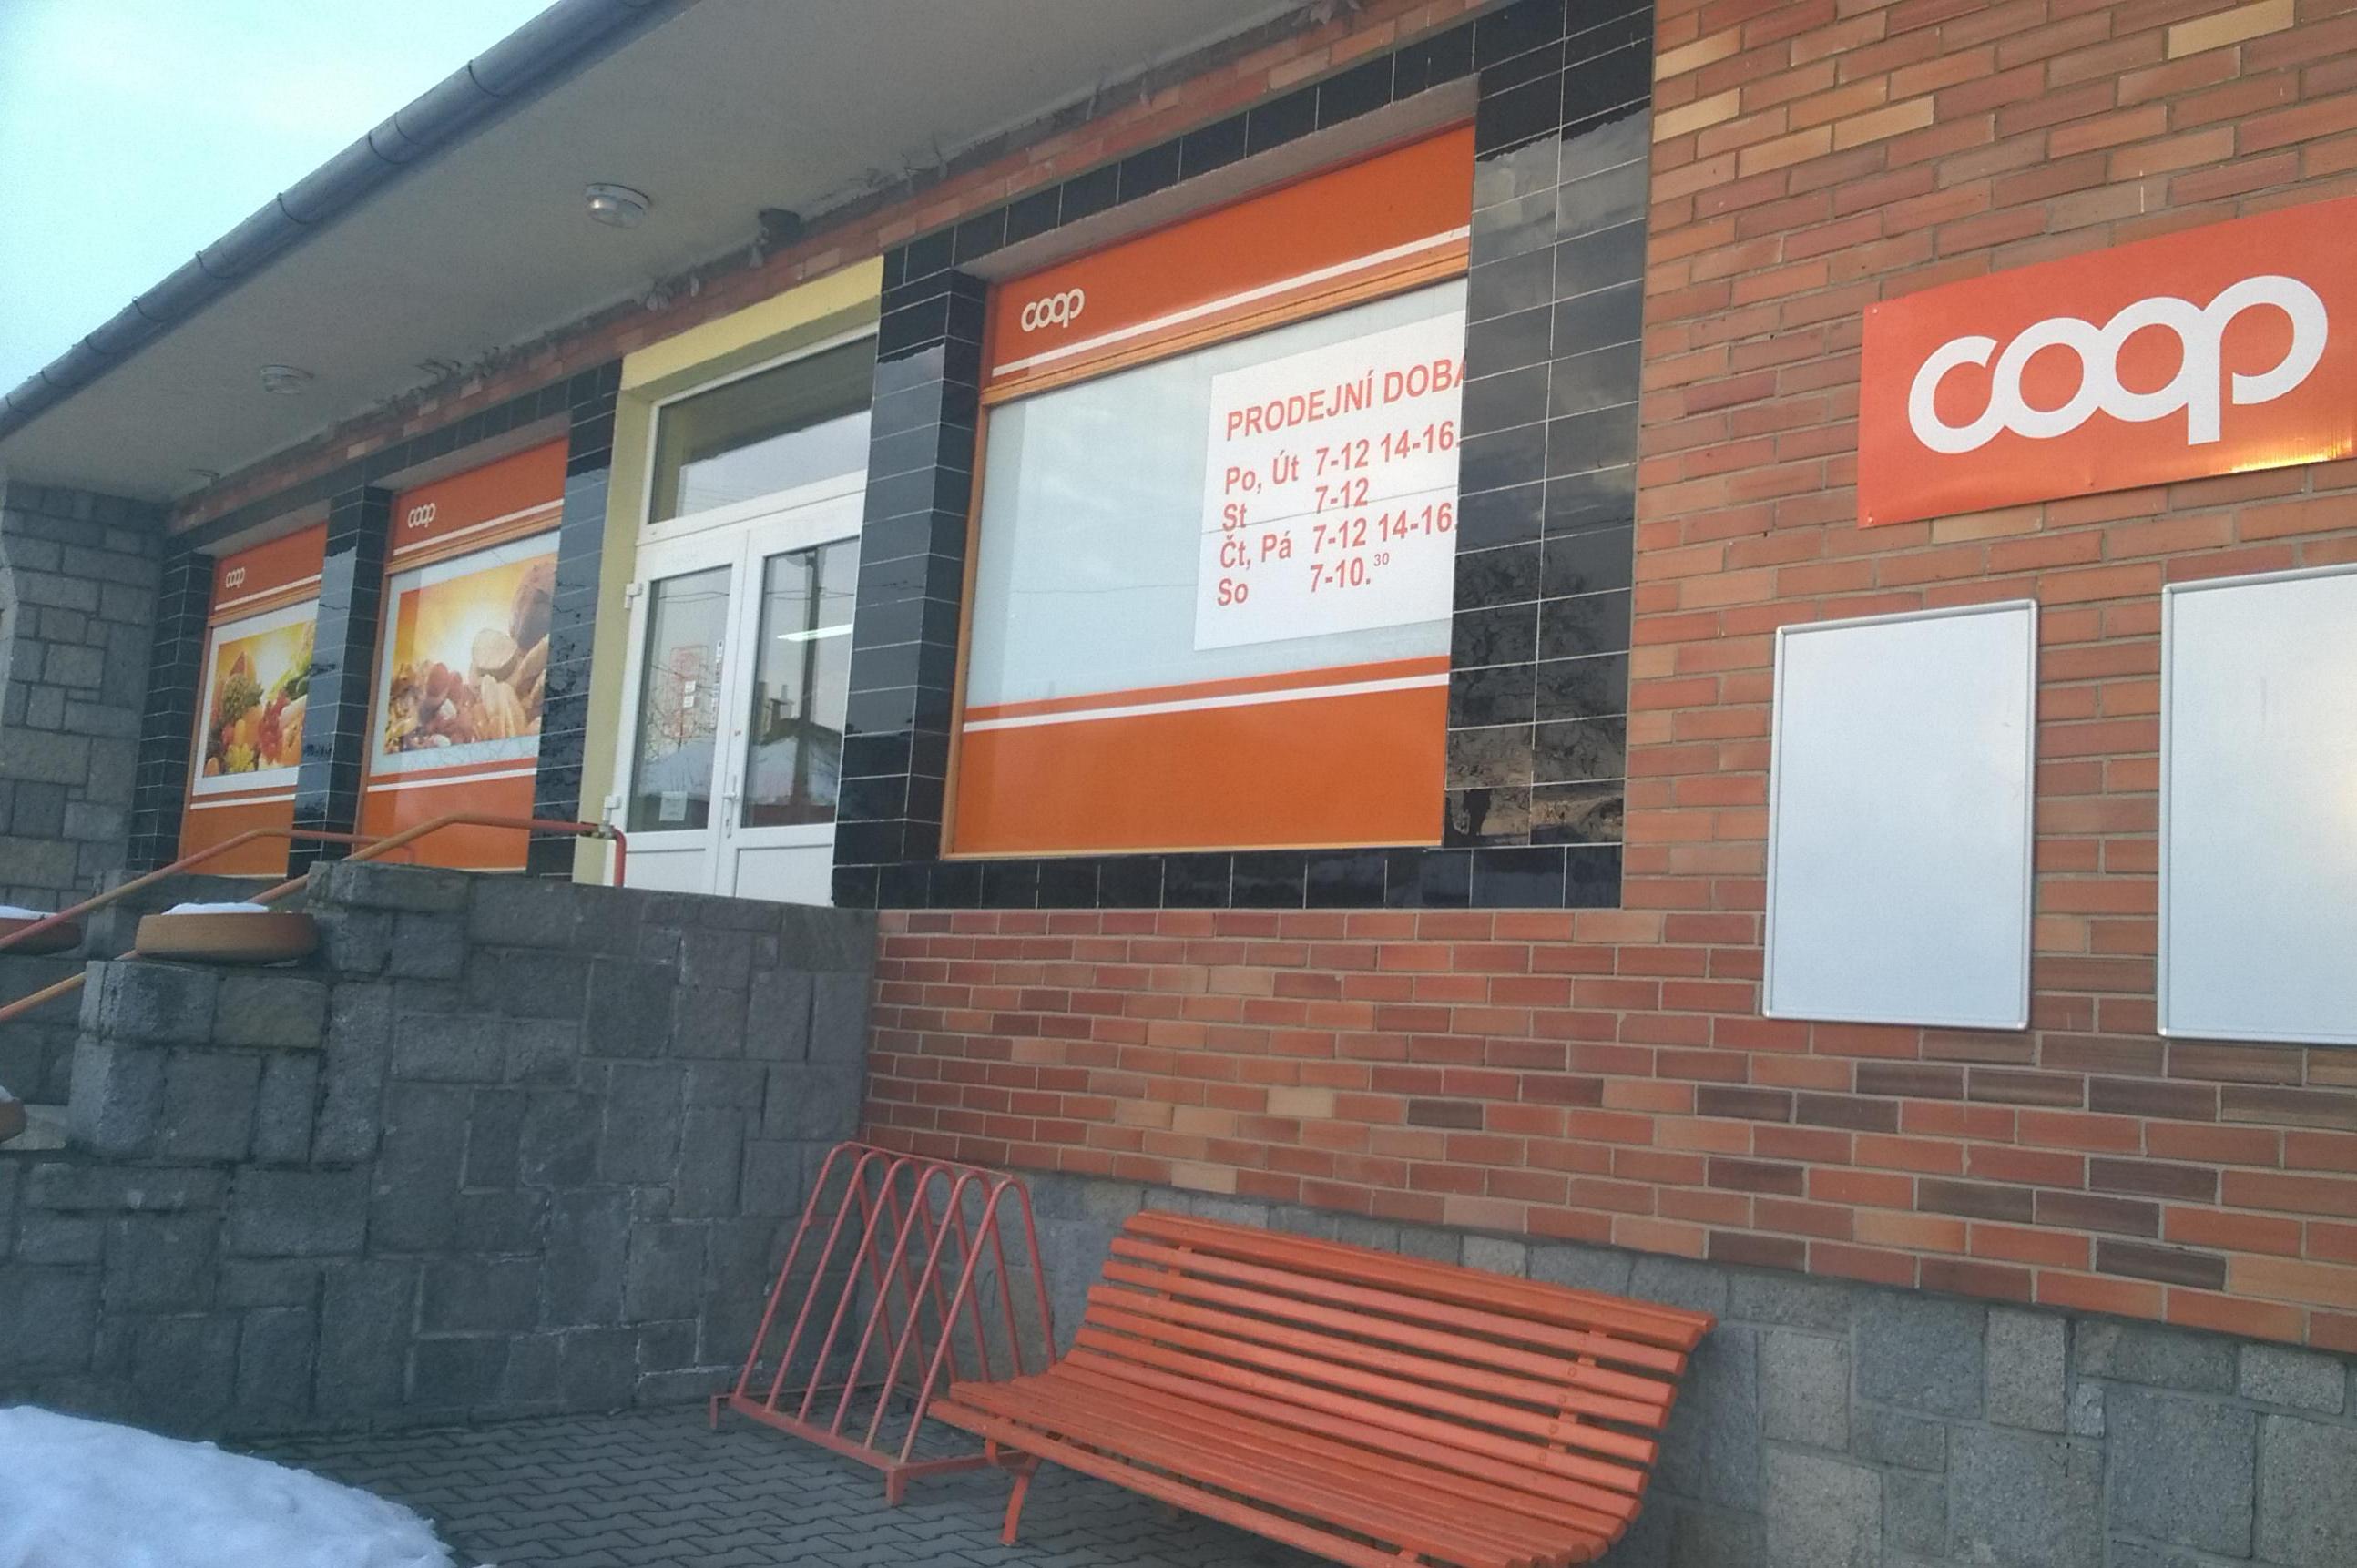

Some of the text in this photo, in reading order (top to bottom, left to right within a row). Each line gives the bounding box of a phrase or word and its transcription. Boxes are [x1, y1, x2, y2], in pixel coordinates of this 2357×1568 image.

[1021, 288, 1085, 331] coop
[1909, 275, 2329, 454] coop
[1227, 370, 1374, 441] PRODEJNÍ
[1225, 466, 1262, 494] Po,
[1272, 450, 1299, 484] Út
[1315, 439, 1370, 476] 7-12
[408, 503, 436, 528] coop
[1222, 478, 1369, 532] St 7-12
[1220, 533, 1250, 570] Čt,
[1261, 531, 1291, 562] Pá
[1313, 518, 1366, 554] 7-12
[225, 567, 245, 588] coop
[1218, 578, 1249, 606] So
